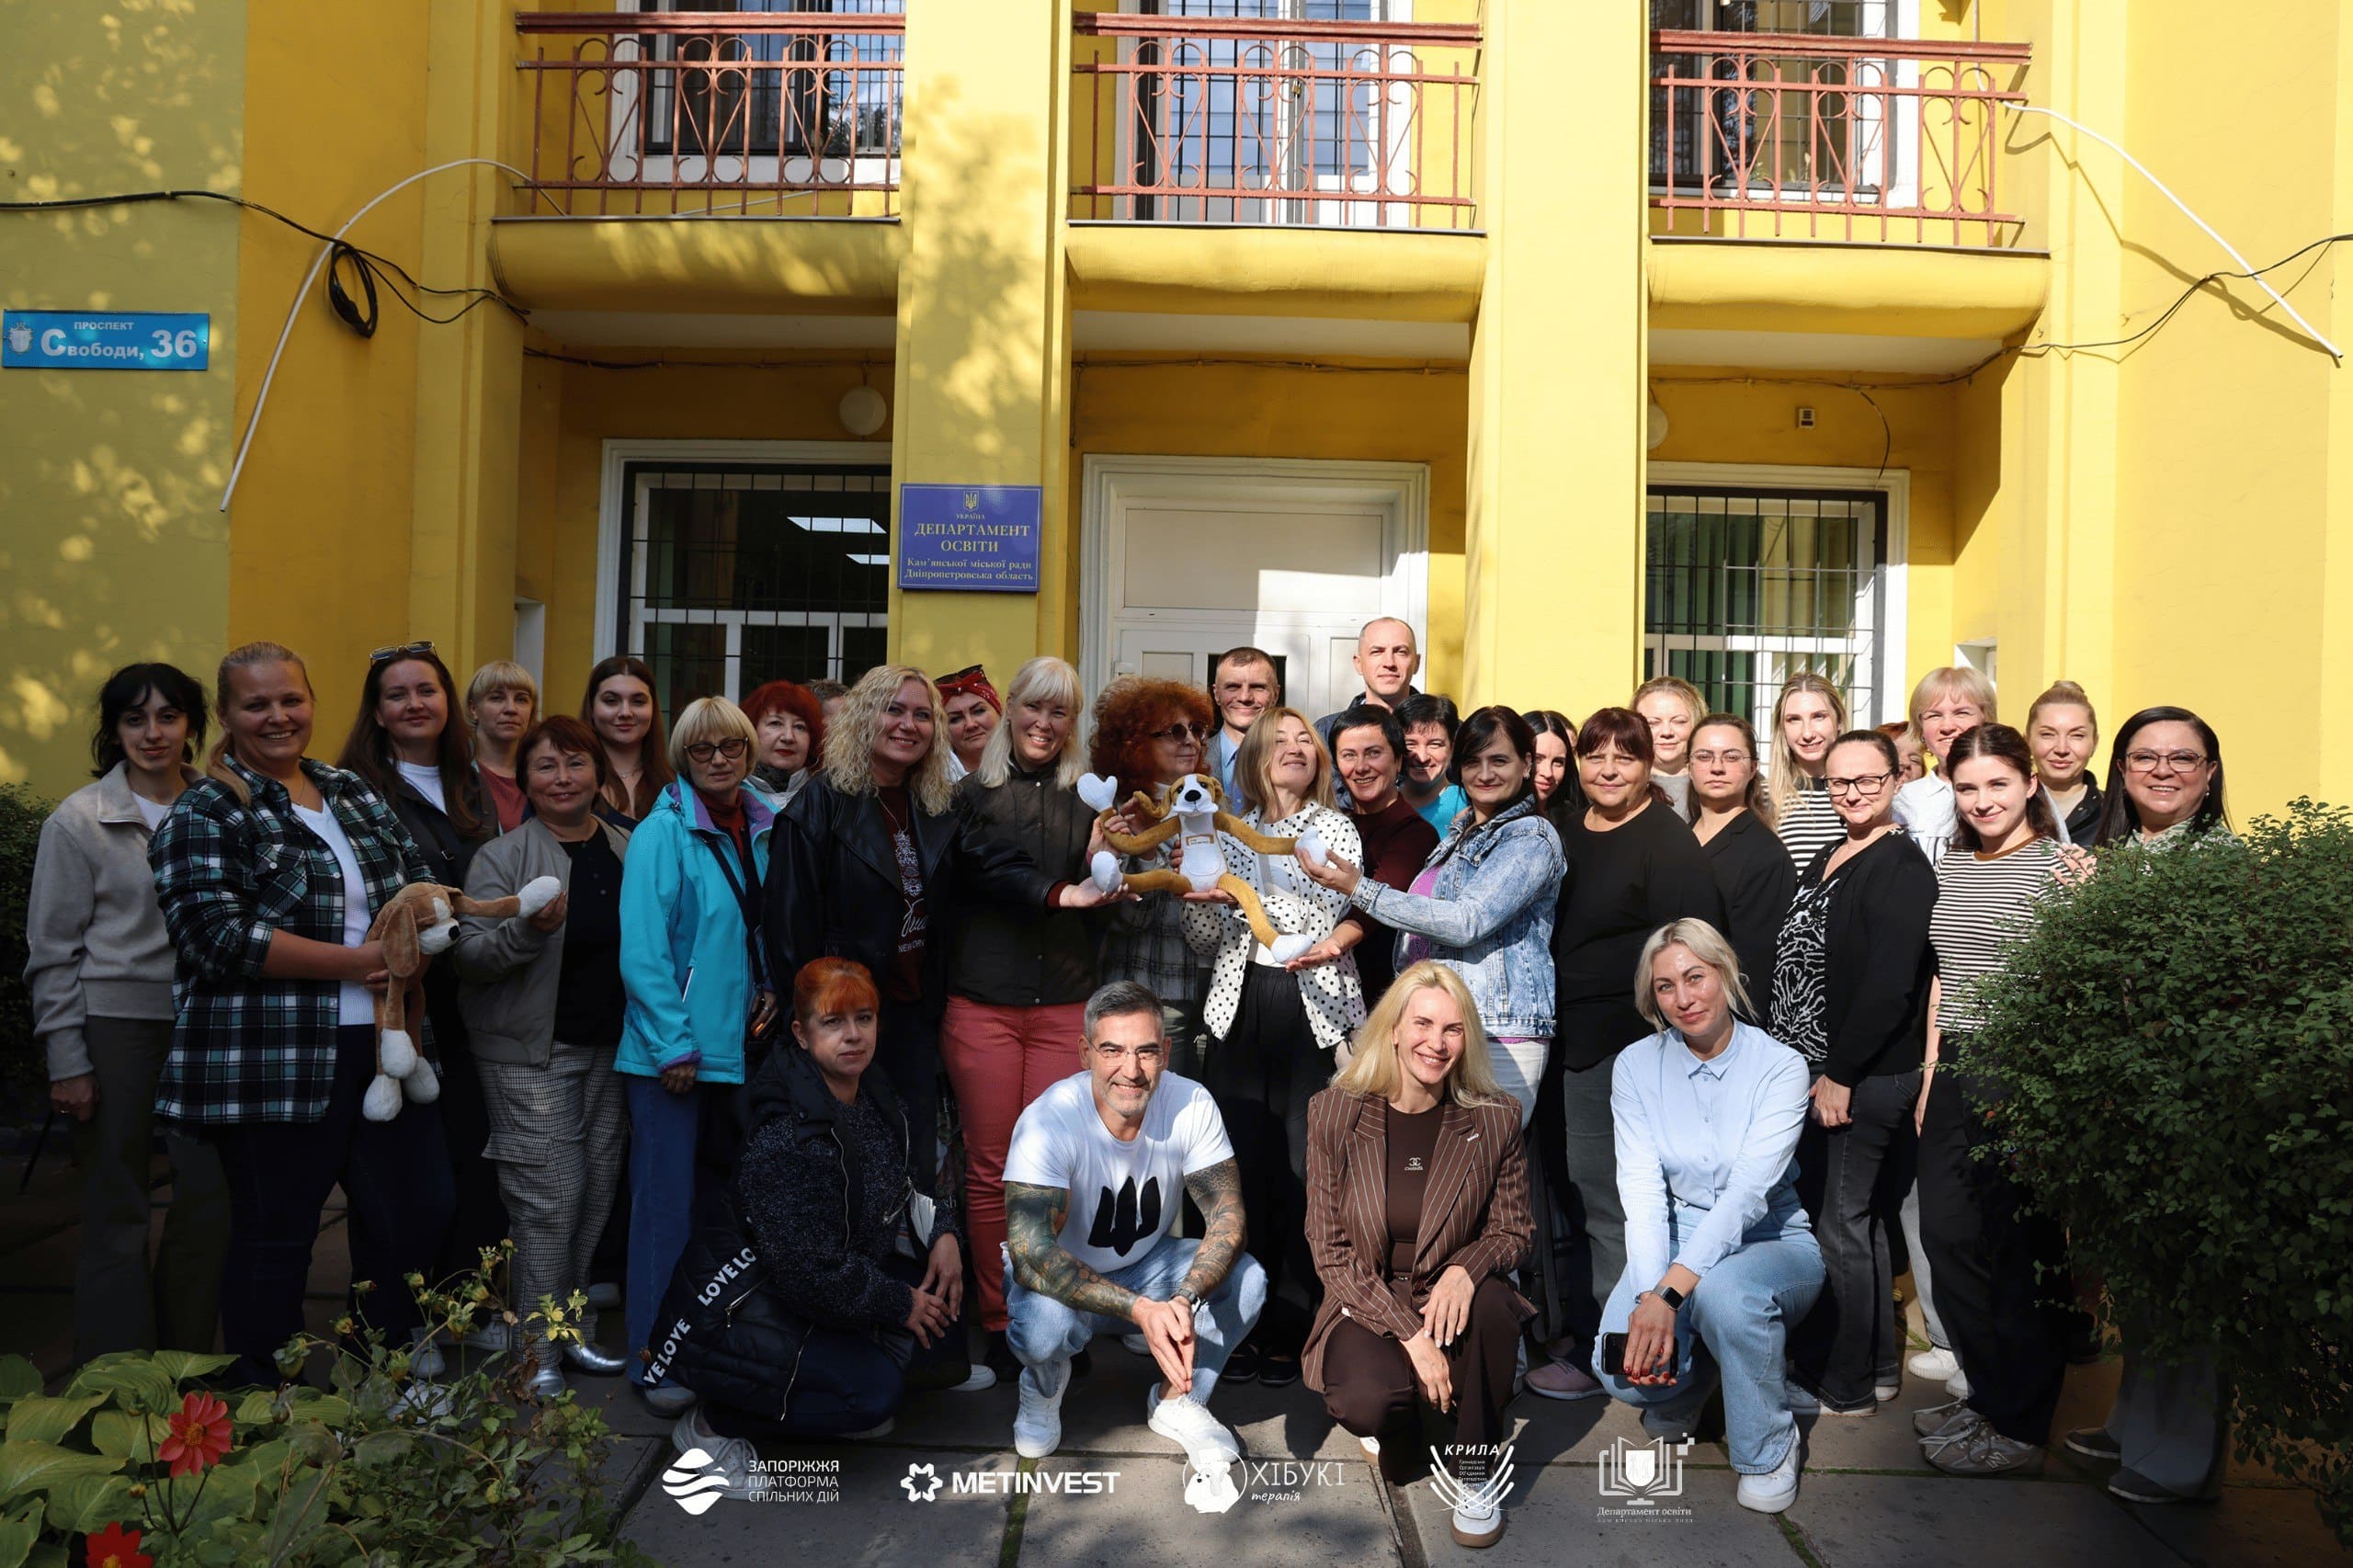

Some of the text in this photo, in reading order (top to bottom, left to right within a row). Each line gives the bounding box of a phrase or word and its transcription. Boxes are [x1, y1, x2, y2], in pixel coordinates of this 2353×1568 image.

[74, 321, 134, 331] ПРОСПЕКТ
[40, 328, 197, 360] Свободи, 36
[915, 523, 1030, 537] ДЕПАРТАМЕНТ
[940, 540, 998, 552] ОСВІТИ
[971, 559, 1006, 569] міської
[1008, 562, 1031, 571] ради
[904, 569, 1033, 581] Дніпропетровська область
